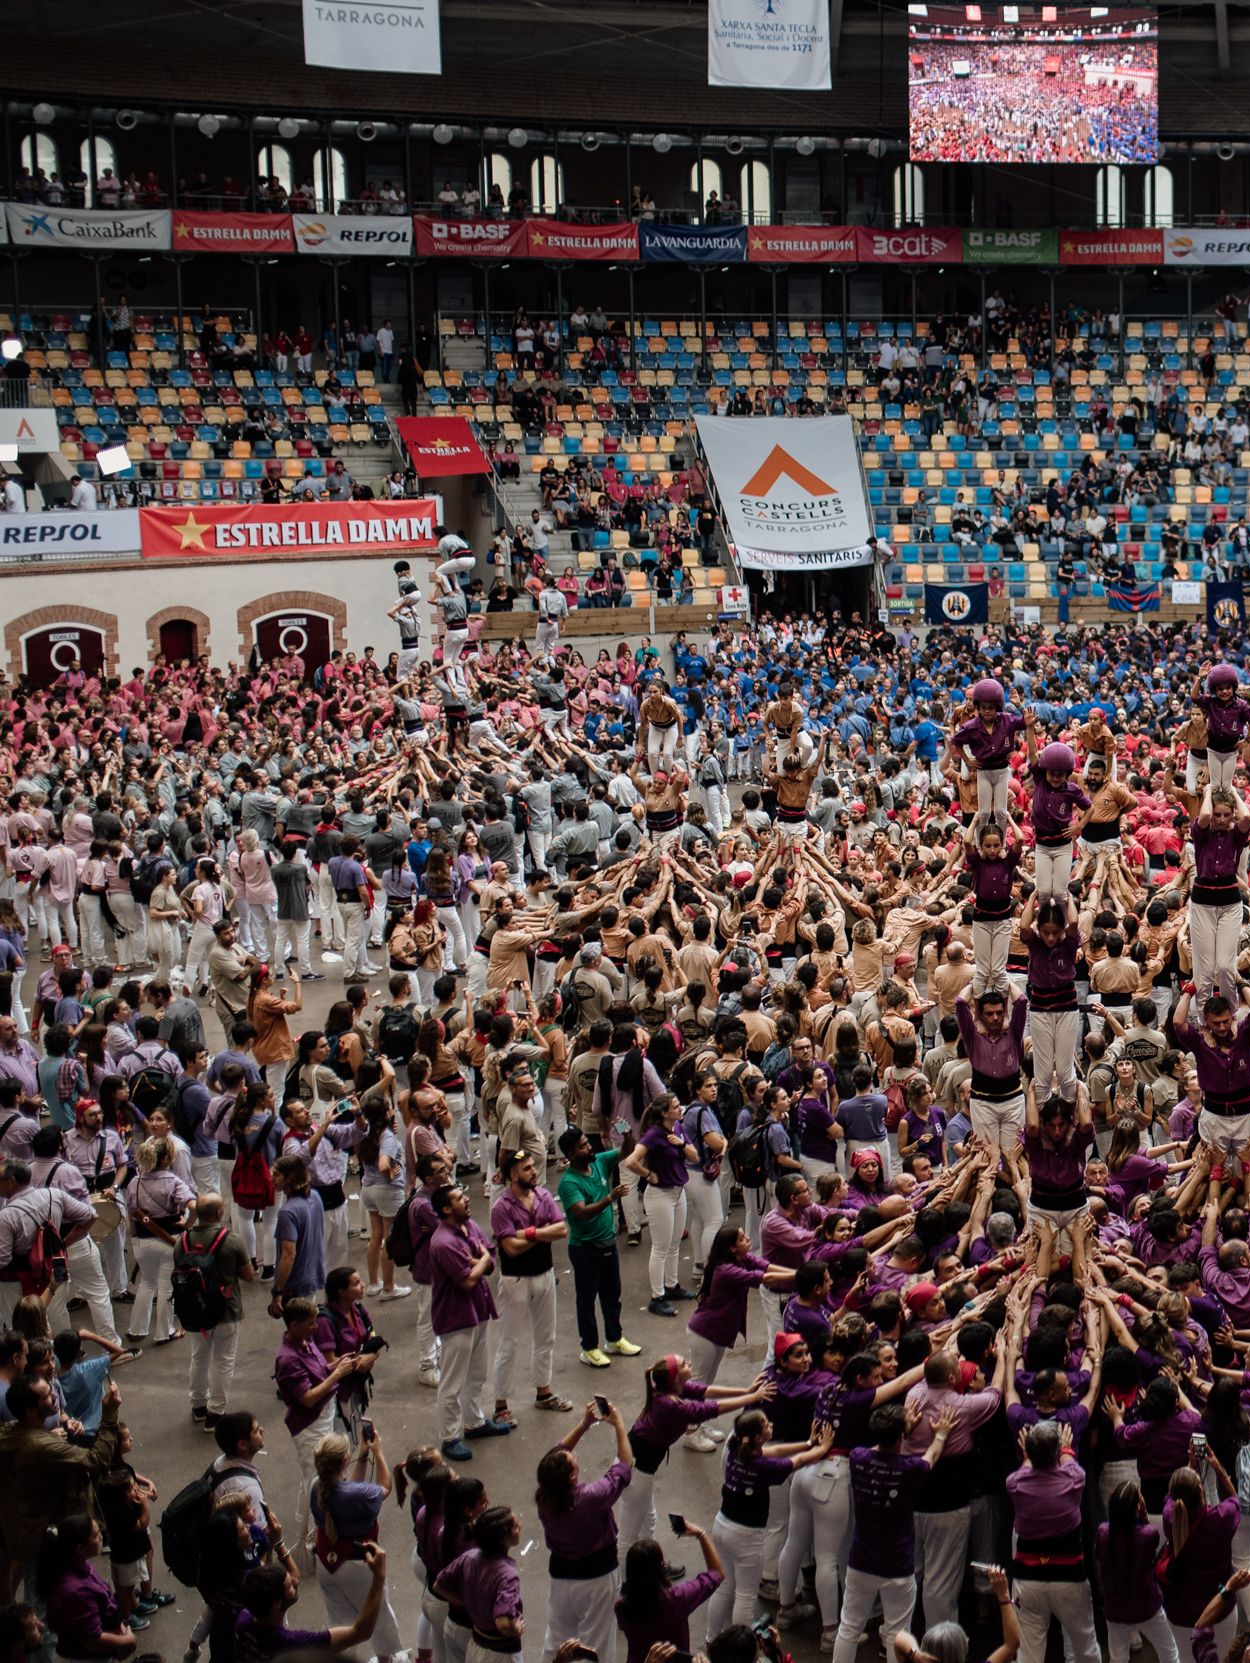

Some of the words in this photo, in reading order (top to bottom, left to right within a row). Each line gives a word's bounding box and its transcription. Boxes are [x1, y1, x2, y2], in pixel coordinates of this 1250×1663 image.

[315, 7, 425, 28] TARRAGONA
[721, 19, 752, 31] XARXA
[755, 22, 786, 32] SANTA
[788, 23, 817, 34] TECLA
[757, 33, 784, 42] Social
[733, 42, 765, 51] Tarragona
[792, 44, 813, 54] 1171
[58, 217, 157, 239] CaixaBank
[193, 227, 251, 240] ESTRELLA
[252, 228, 291, 240] DAMM
[459, 224, 510, 238] BASF
[340, 230, 409, 243] REPSOL
[547, 236, 601, 248] ESTRELLA
[602, 237, 637, 248] DAMM
[645, 236, 661, 248] LA
[661, 236, 742, 249] VANGUARDIA
[994, 232, 1041, 247] BASF
[434, 242, 446, 251] We
[447, 243, 473, 252] create
[473, 243, 511, 254] chemistry
[767, 239, 818, 251] ESTRELLA
[820, 239, 854, 250] DAMM
[873, 233, 929, 255] 3cat
[1077, 242, 1127, 254] ESTRELLA
[1129, 242, 1162, 253] DAMM
[969, 249, 982, 258] We
[983, 250, 1006, 259] create
[418, 446, 471, 454] ESTRELLA
[740, 498, 842, 511] CONCURS
[742, 506, 844, 520] CASTELLS
[215, 519, 343, 548] ESTRELLA
[348, 516, 433, 544] DAMM
[745, 520, 848, 533] TARRAGONA
[3, 523, 102, 545] REPSOL
[746, 550, 794, 565] SERVEIS
[798, 550, 863, 565] SANITARIS
[890, 600, 914, 608] SORTIDA
